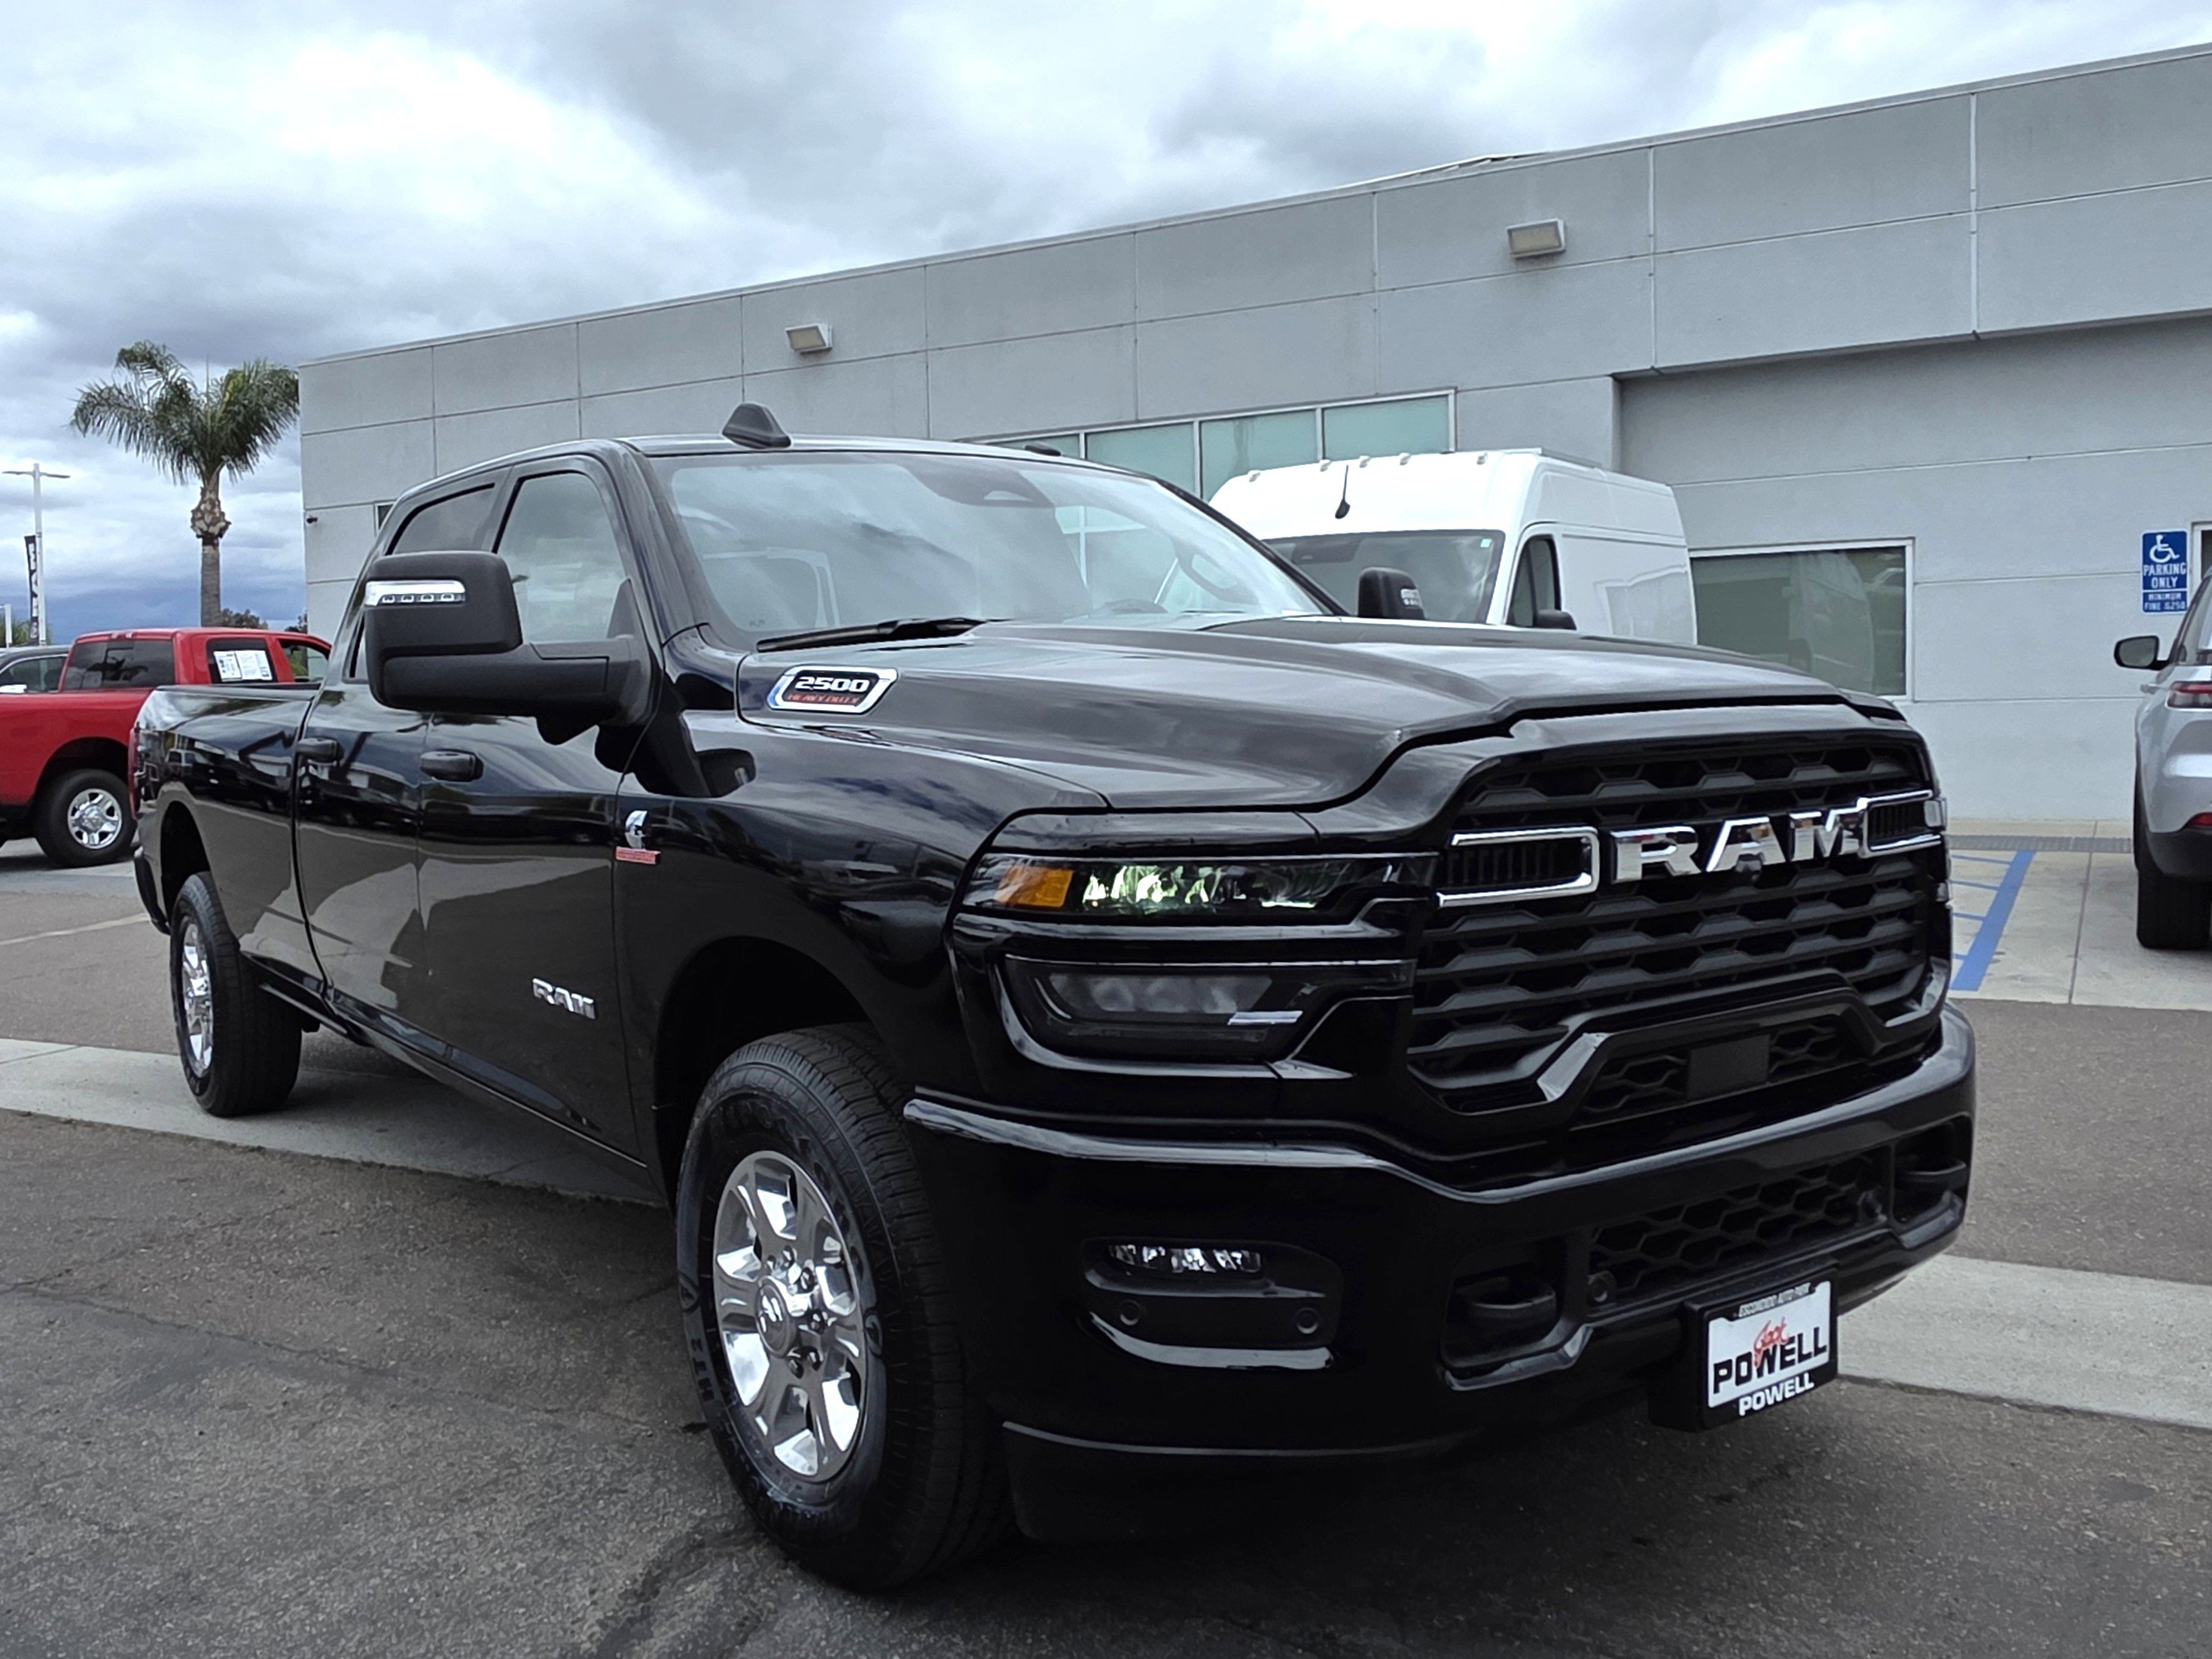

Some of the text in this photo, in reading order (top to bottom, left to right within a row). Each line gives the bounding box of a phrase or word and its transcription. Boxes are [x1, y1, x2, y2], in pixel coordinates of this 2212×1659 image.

[2143, 562, 2186, 576] PARKING
[2151, 576, 2178, 589] ONLY
[794, 676, 870, 693] 2500
[1610, 807, 1863, 884] RAM
[532, 978, 596, 1019] RAM
[1713, 1326, 1827, 1394] POWELL
[1738, 1372, 1814, 1417] POWELL
